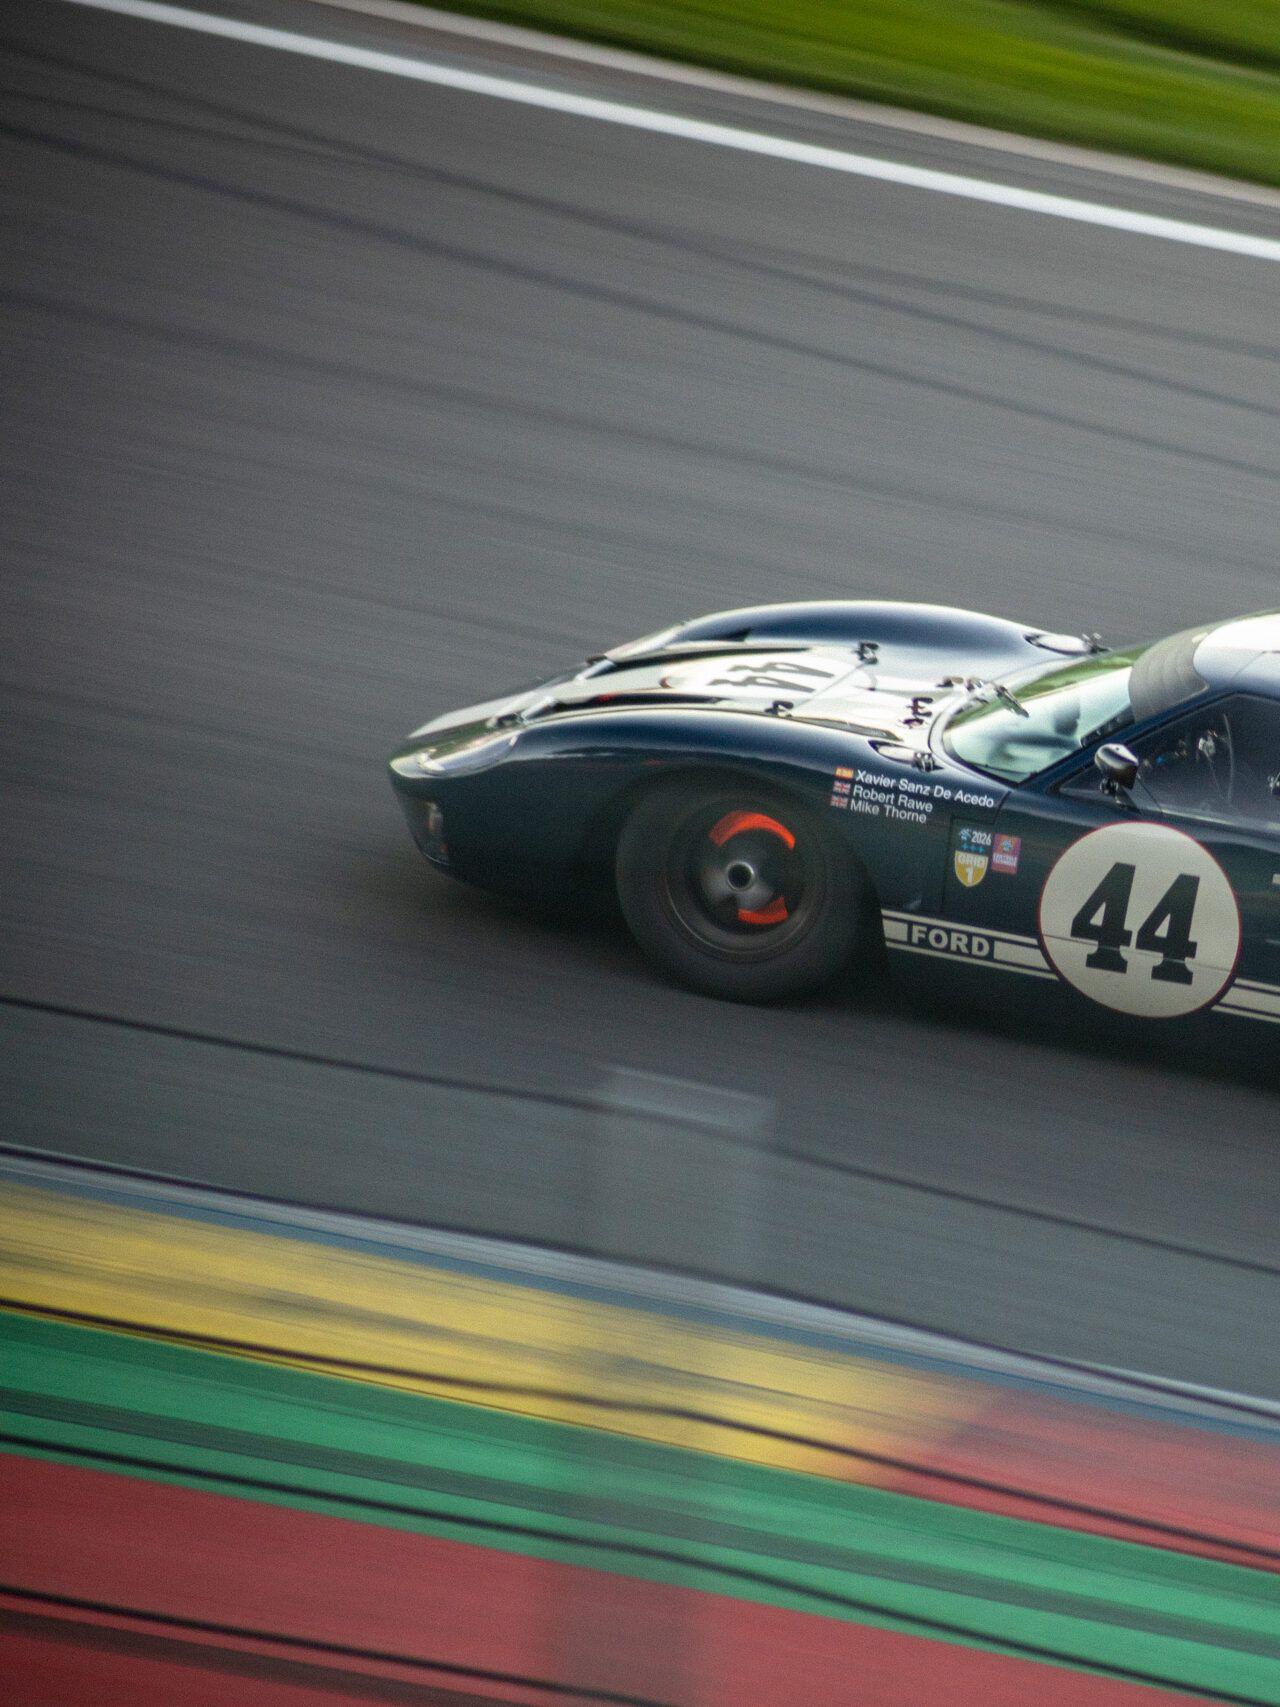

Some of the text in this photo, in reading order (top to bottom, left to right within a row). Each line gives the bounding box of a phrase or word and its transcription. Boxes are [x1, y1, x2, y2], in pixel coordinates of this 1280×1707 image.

[853, 785, 934, 813] Robert Rawe
[856, 769, 994, 808] Xavier Sanz De Acedo
[850, 799, 927, 824] Mike Thorne
[971, 831, 992, 846] 2026
[1070, 861, 1201, 986] 44
[911, 924, 990, 957] FORD
